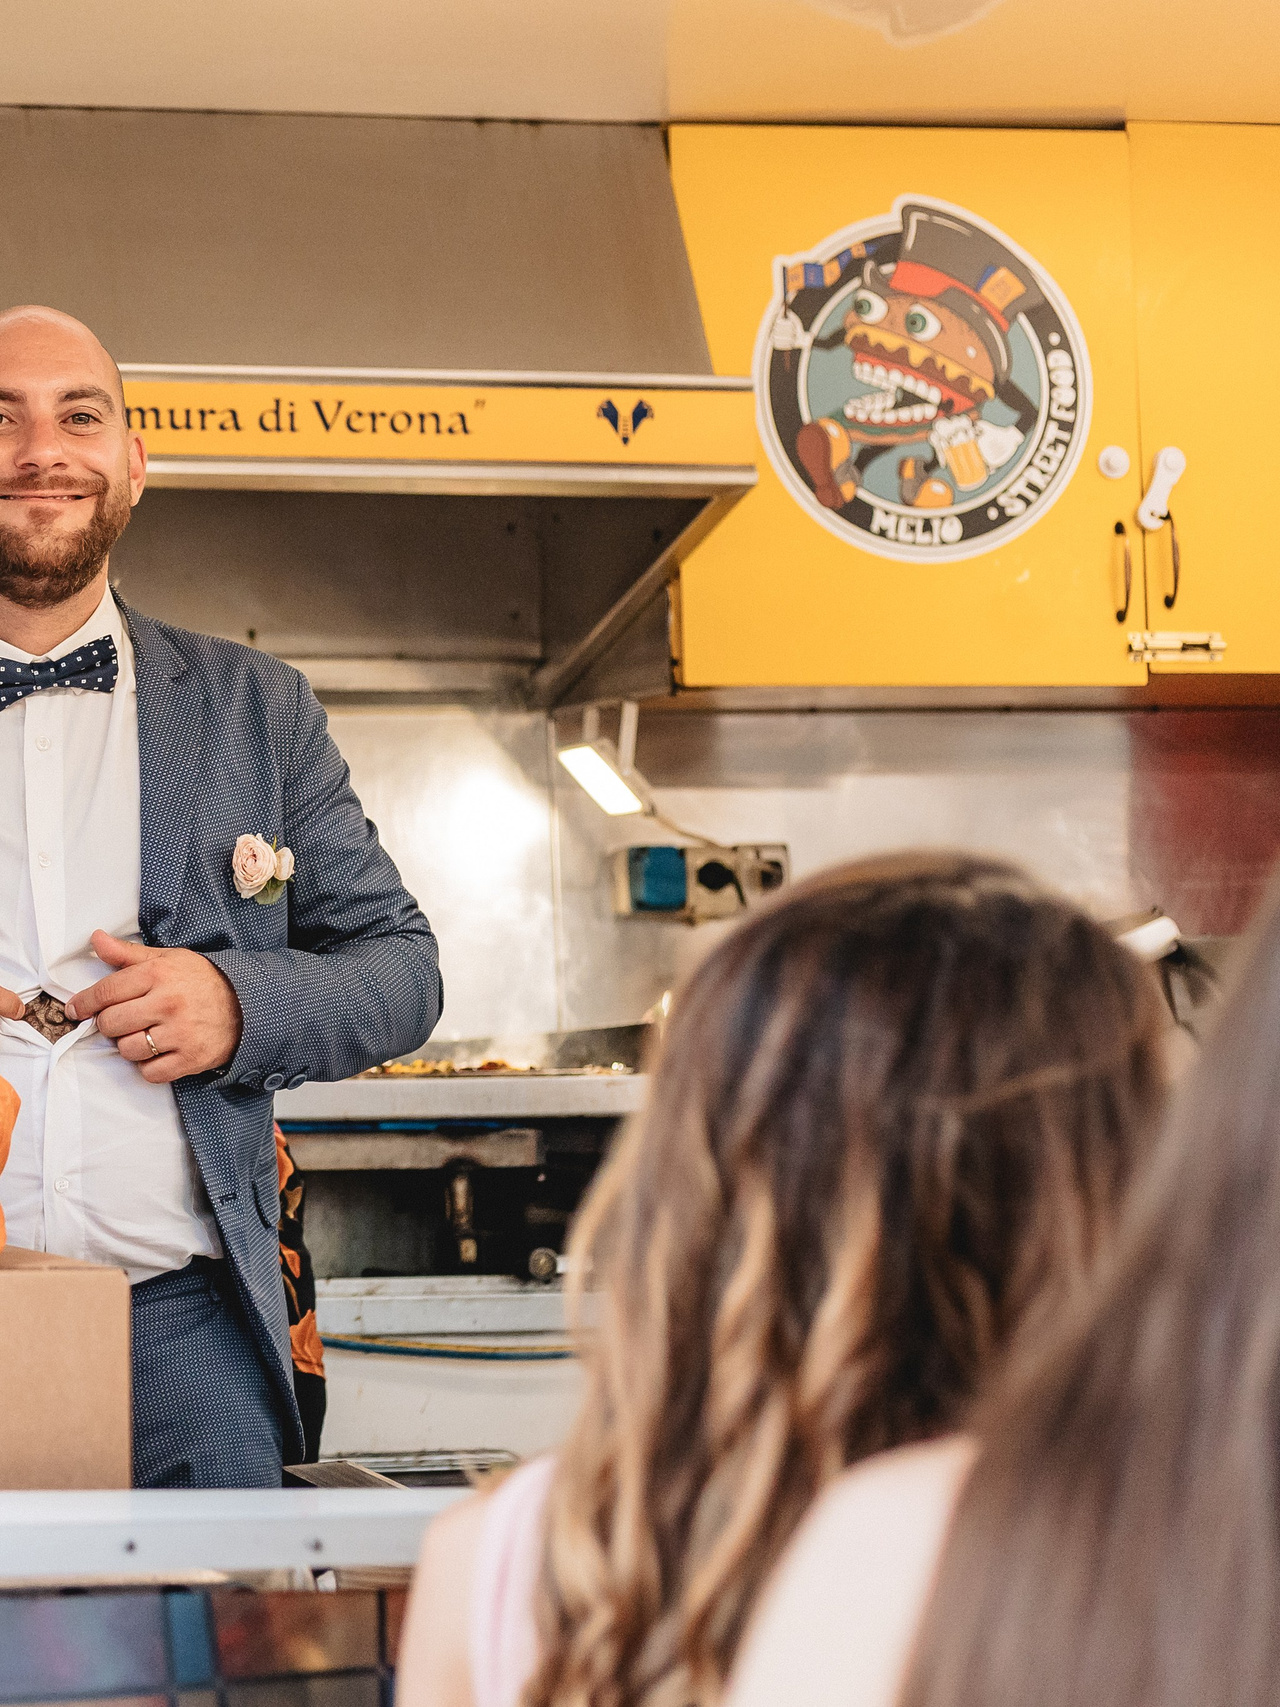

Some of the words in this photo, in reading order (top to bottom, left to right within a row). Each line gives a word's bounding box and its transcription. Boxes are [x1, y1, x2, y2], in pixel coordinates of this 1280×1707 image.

[124, 406, 242, 432] mura
[258, 398, 299, 433] di
[870, 507, 964, 545] MELIO
[997, 420, 1071, 517] STREET
[1046, 349, 1077, 423] FOOD
